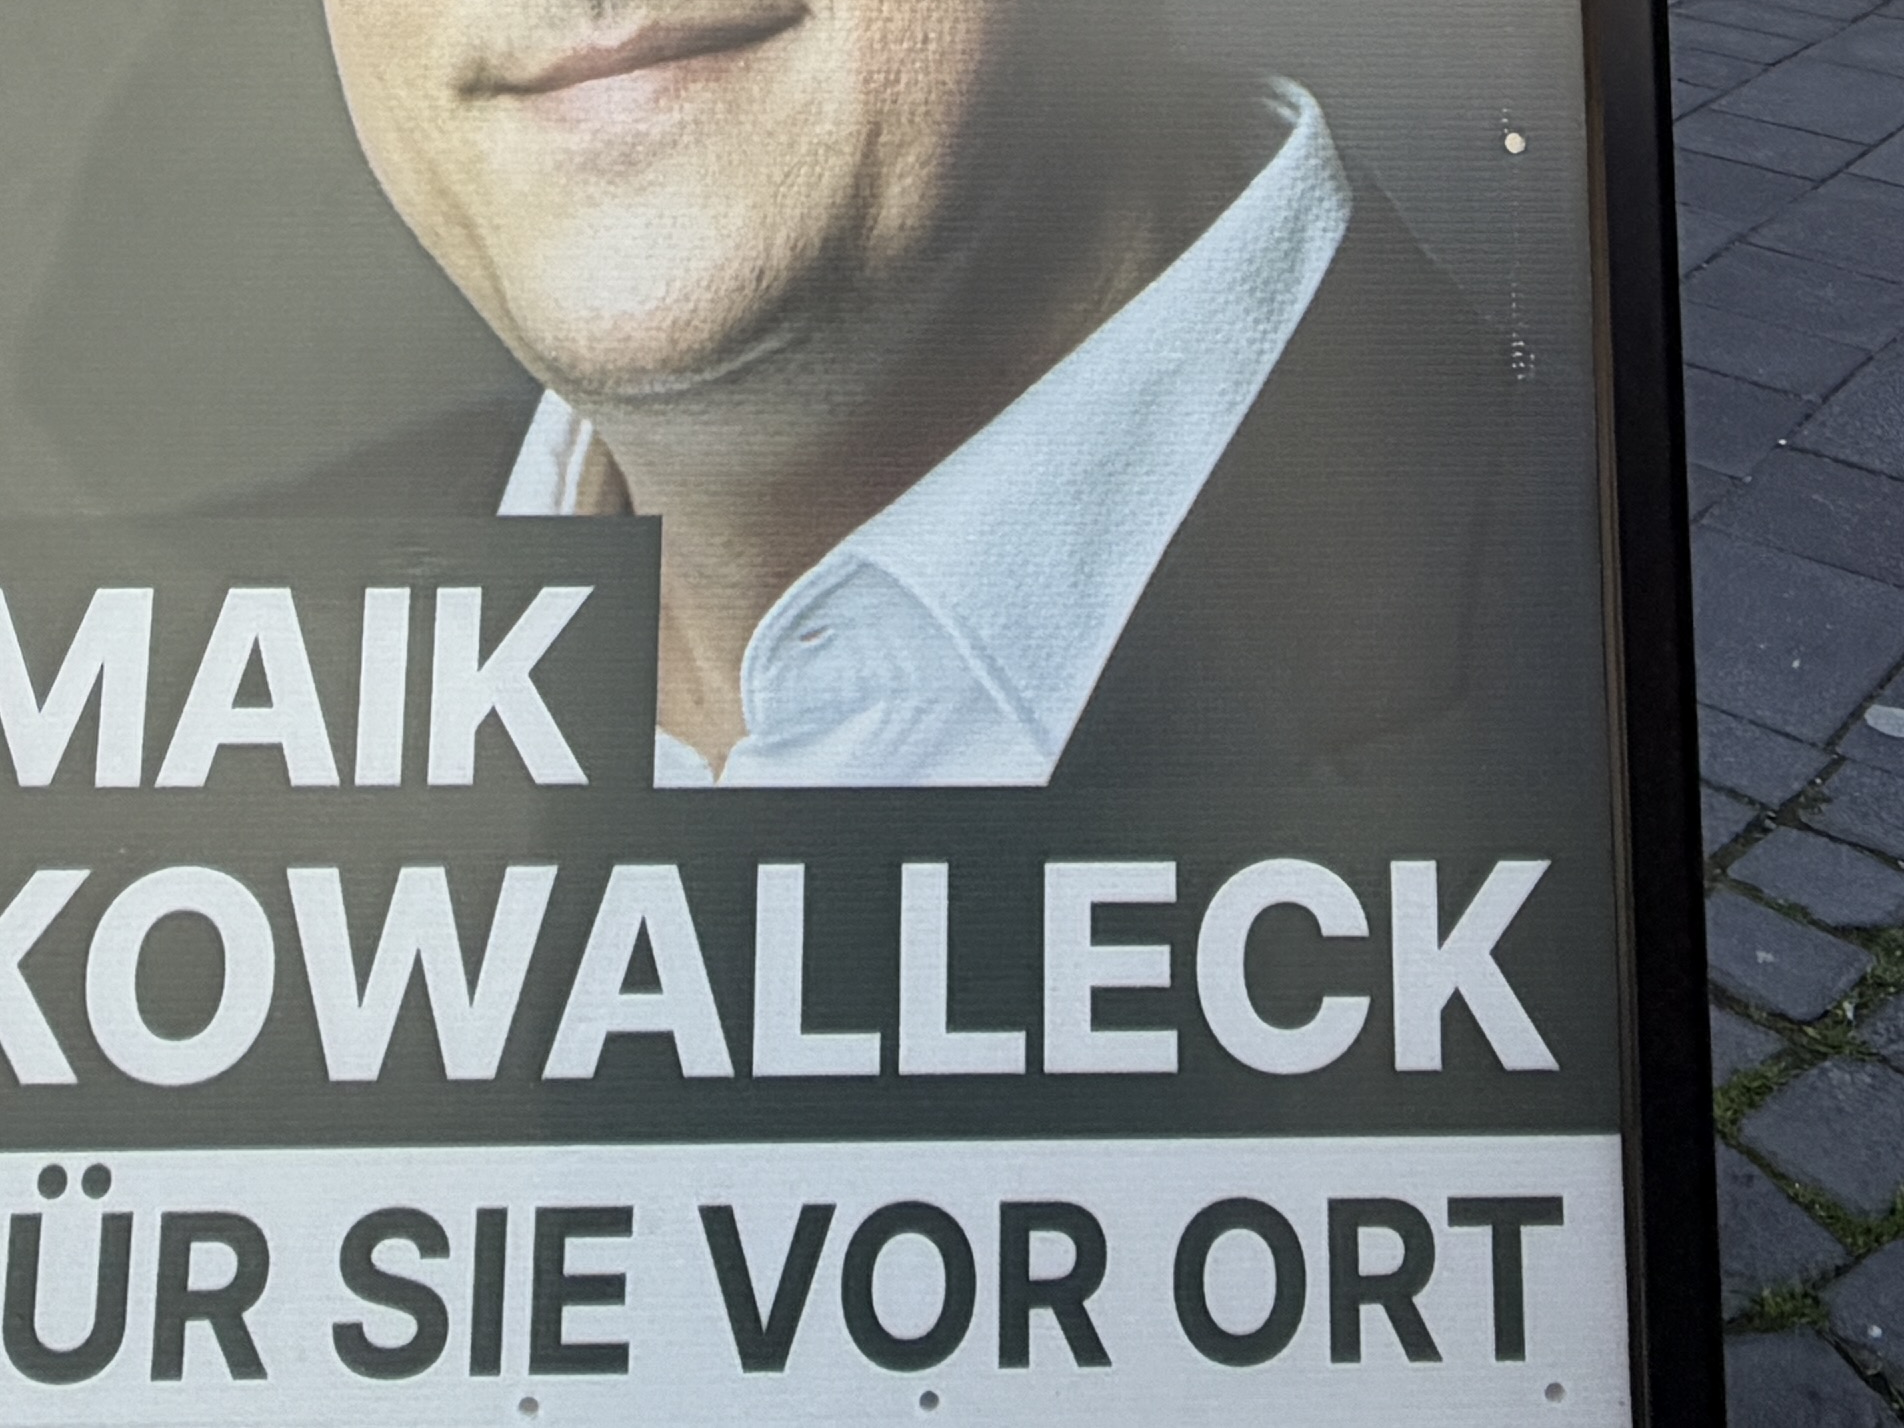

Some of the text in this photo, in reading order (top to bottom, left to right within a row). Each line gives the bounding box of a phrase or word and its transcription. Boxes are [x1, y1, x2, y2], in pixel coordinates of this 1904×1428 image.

[332, 1205, 635, 1381] SIE
[698, 1199, 1113, 1374] VOR
[1172, 1194, 1566, 1368] ORT
